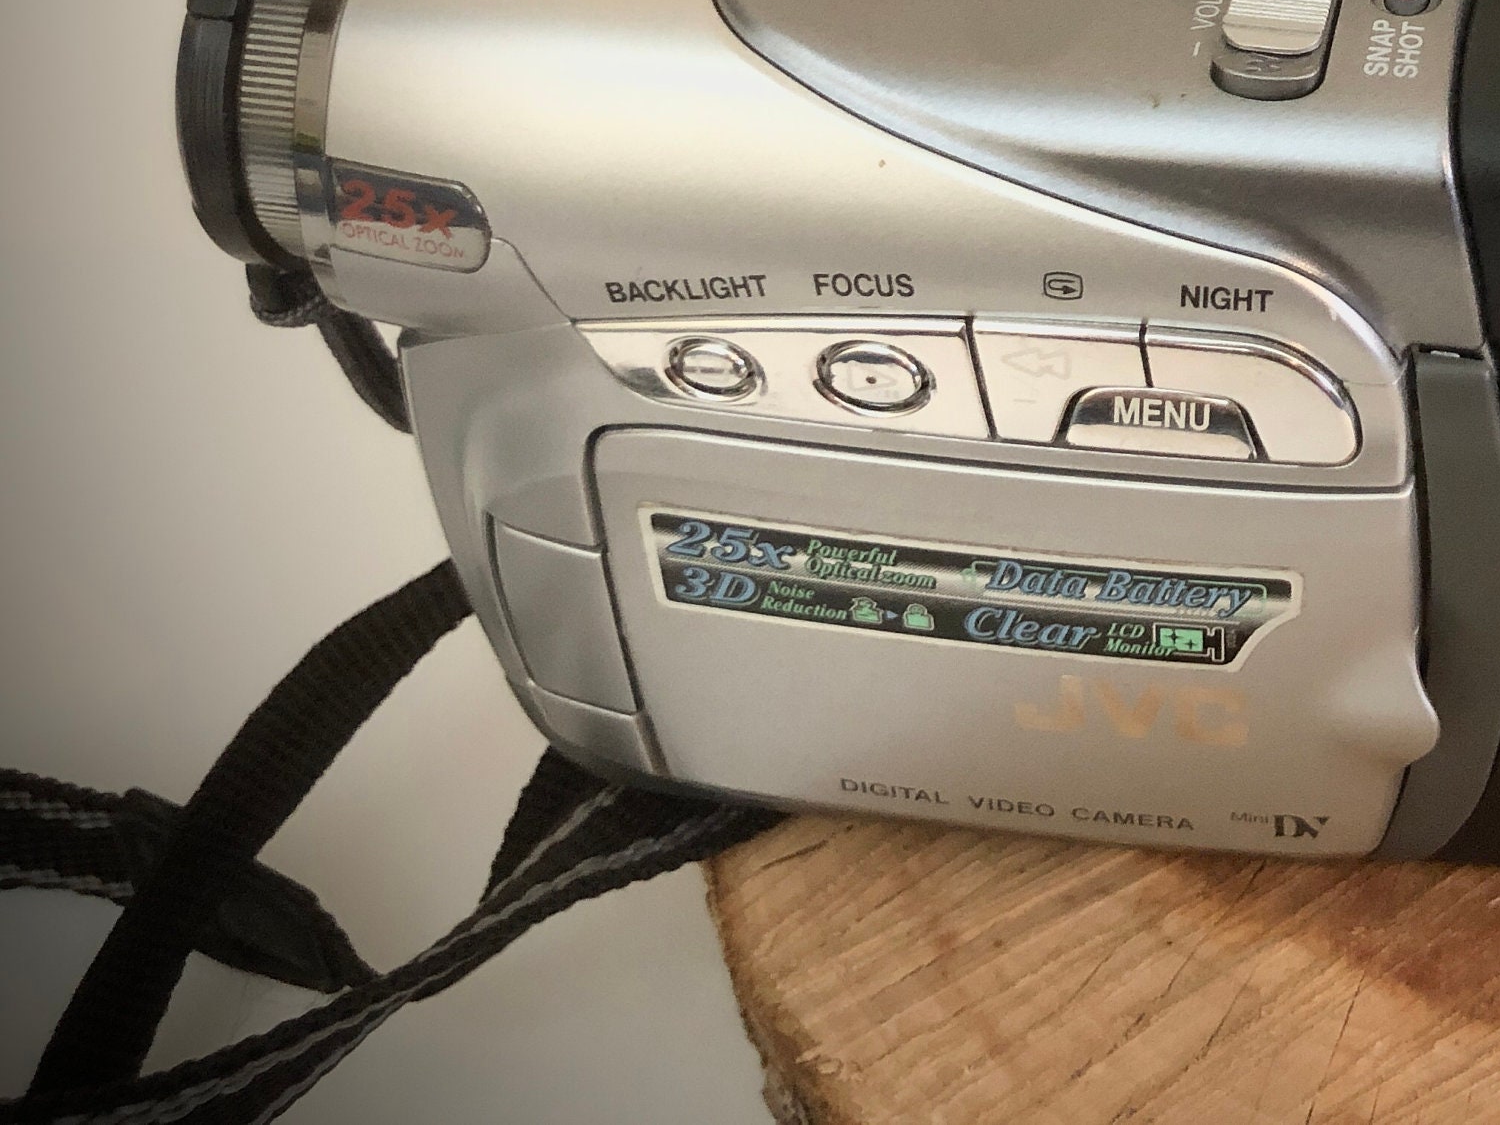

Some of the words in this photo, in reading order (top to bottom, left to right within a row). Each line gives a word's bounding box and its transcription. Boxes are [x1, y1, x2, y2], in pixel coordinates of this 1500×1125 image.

[1363, 19, 1396, 77] SNAP
[1393, 21, 1426, 79] SHOT
[341, 179, 458, 240] 25x
[340, 222, 410, 250] OPTICAL
[605, 275, 767, 303] BACKLIGHT
[812, 273, 915, 297] FOCUS
[1180, 284, 1274, 312] NIGHT
[1113, 395, 1211, 432] MENU
[666, 520, 797, 570] 25x
[806, 539, 898, 566] Powerful
[674, 566, 762, 607] 3D
[767, 580, 816, 600] Noise
[805, 555, 878, 583] Optical
[881, 569, 937, 590] zoom
[986, 559, 1088, 600] Data
[1096, 569, 1251, 619] Battery
[761, 596, 848, 622] Reduction
[964, 605, 1101, 649] Clear
[1107, 622, 1146, 639] LCD
[1103, 638, 1175, 657] Monitor
[1014, 674, 1248, 747] JVC
[840, 777, 950, 805] DIGITAL
[968, 794, 1055, 818] VIDEO
[1071, 806, 1196, 832] CAMERA
[1230, 810, 1269, 825] Mini
[1272, 813, 1331, 839] DV
